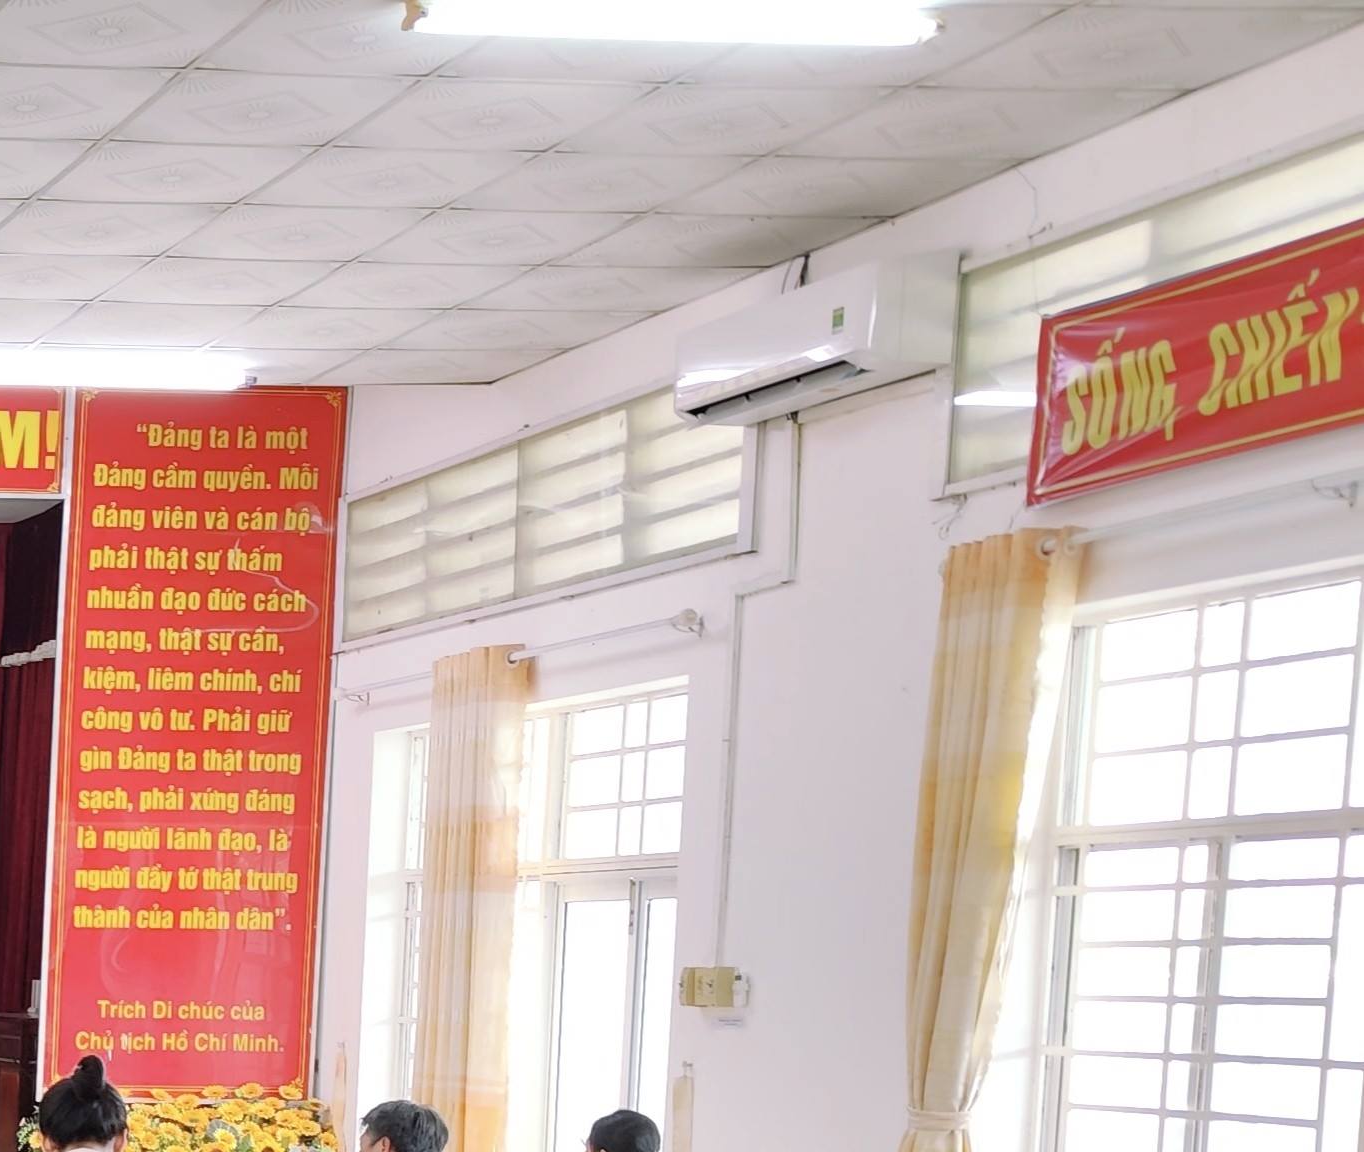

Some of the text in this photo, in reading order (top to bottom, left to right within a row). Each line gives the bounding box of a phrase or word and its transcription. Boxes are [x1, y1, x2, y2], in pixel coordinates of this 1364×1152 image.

[1198, 268, 1359, 416] CHIẾN
[210, 426, 229, 449] ta
[237, 426, 256, 450] là
[266, 426, 308, 454] một
[94, 460, 318, 492] Đảng cầm quyền. Mỗi
[92, 502, 310, 536] đảng viên và cán bộ
[89, 543, 283, 575] phải thật sự thấm
[87, 583, 306, 615] nhuần đạo đức cách
[85, 626, 284, 656] mạng, thật sự cần,
[83, 666, 302, 694] kiệm, liêm chính, chí
[81, 706, 293, 734] công vô tư. Phải giữ
[80, 745, 302, 776] gìn Đảng ta thật trong
[78, 786, 295, 814] sạch, phải xứng đáng
[77, 826, 288, 856] là người lãnh đạo, là
[75, 864, 298, 895] người đầy tớ thật trung
[74, 905, 130, 929] thành
[136, 904, 174, 929] của
[180, 908, 229, 930] nhân
[97, 1000, 265, 1020] Trích Di chúc của
[76, 1029, 284, 1054] Chủ tịch Hồ Chí Minh.
